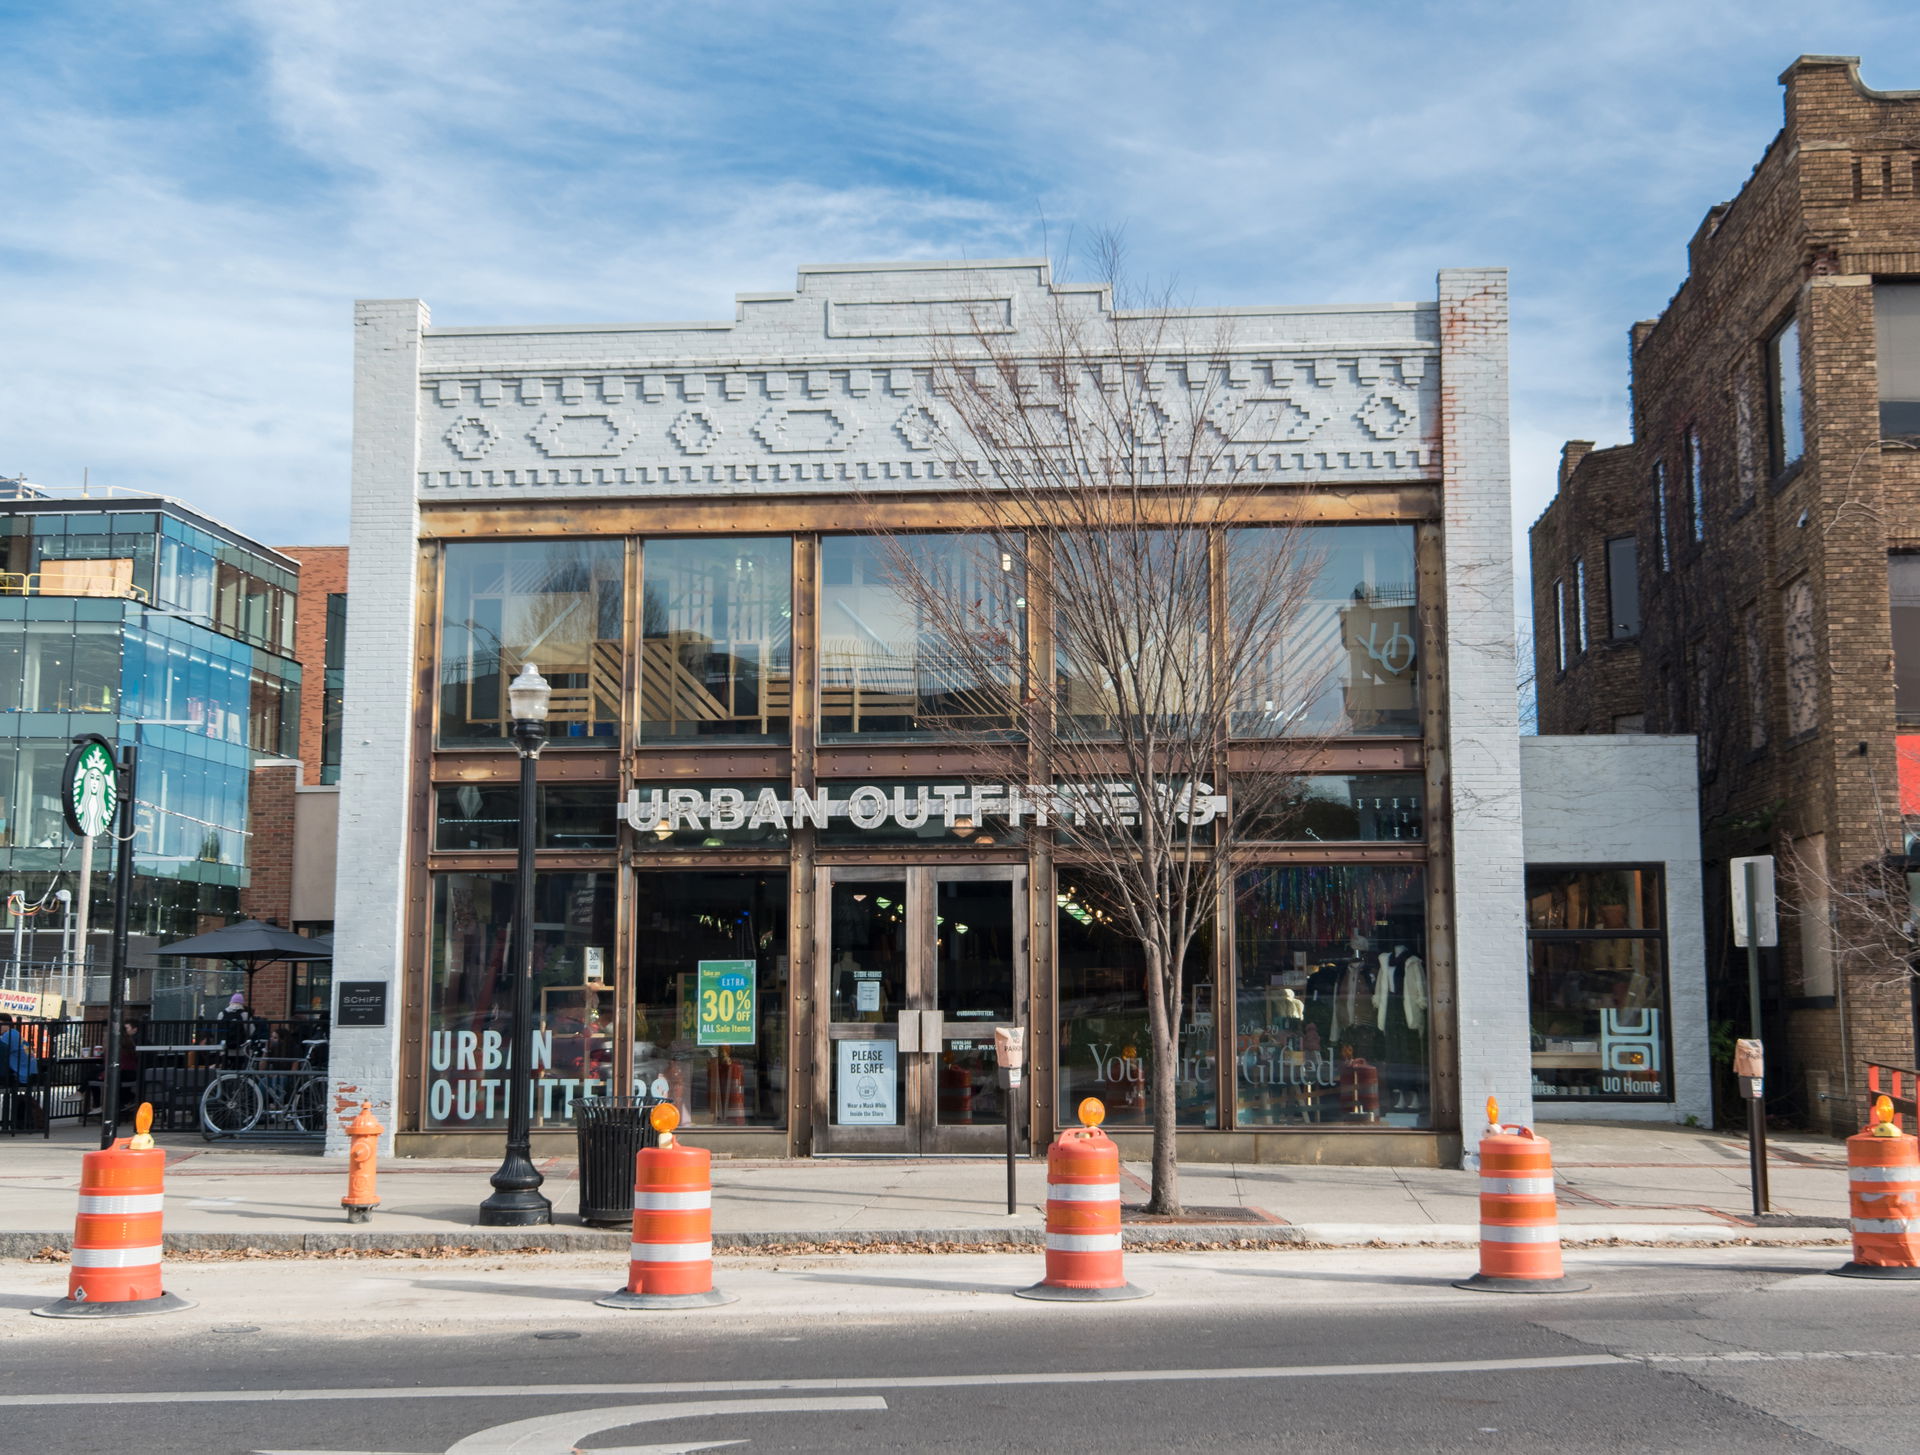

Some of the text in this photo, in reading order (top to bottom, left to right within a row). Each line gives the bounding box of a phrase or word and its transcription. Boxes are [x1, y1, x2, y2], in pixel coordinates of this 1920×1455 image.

[627, 786, 827, 831] URBAN
[721, 978, 745, 987] EXTRA
[343, 996, 382, 1004] SCHIFF
[702, 989, 751, 1022] 30%
[736, 1011, 751, 1022] OFF
[702, 1024, 715, 1033] ALL
[716, 1024, 731, 1033] Sale
[431, 1030, 552, 1072] URBN
[852, 1050, 883, 1061] PLEASE
[850, 1064, 884, 1074] BE SAFE
[1088, 1043, 1145, 1083] You
[1242, 1044, 1337, 1087] Gifted
[1602, 1076, 1661, 1093] UO Home
